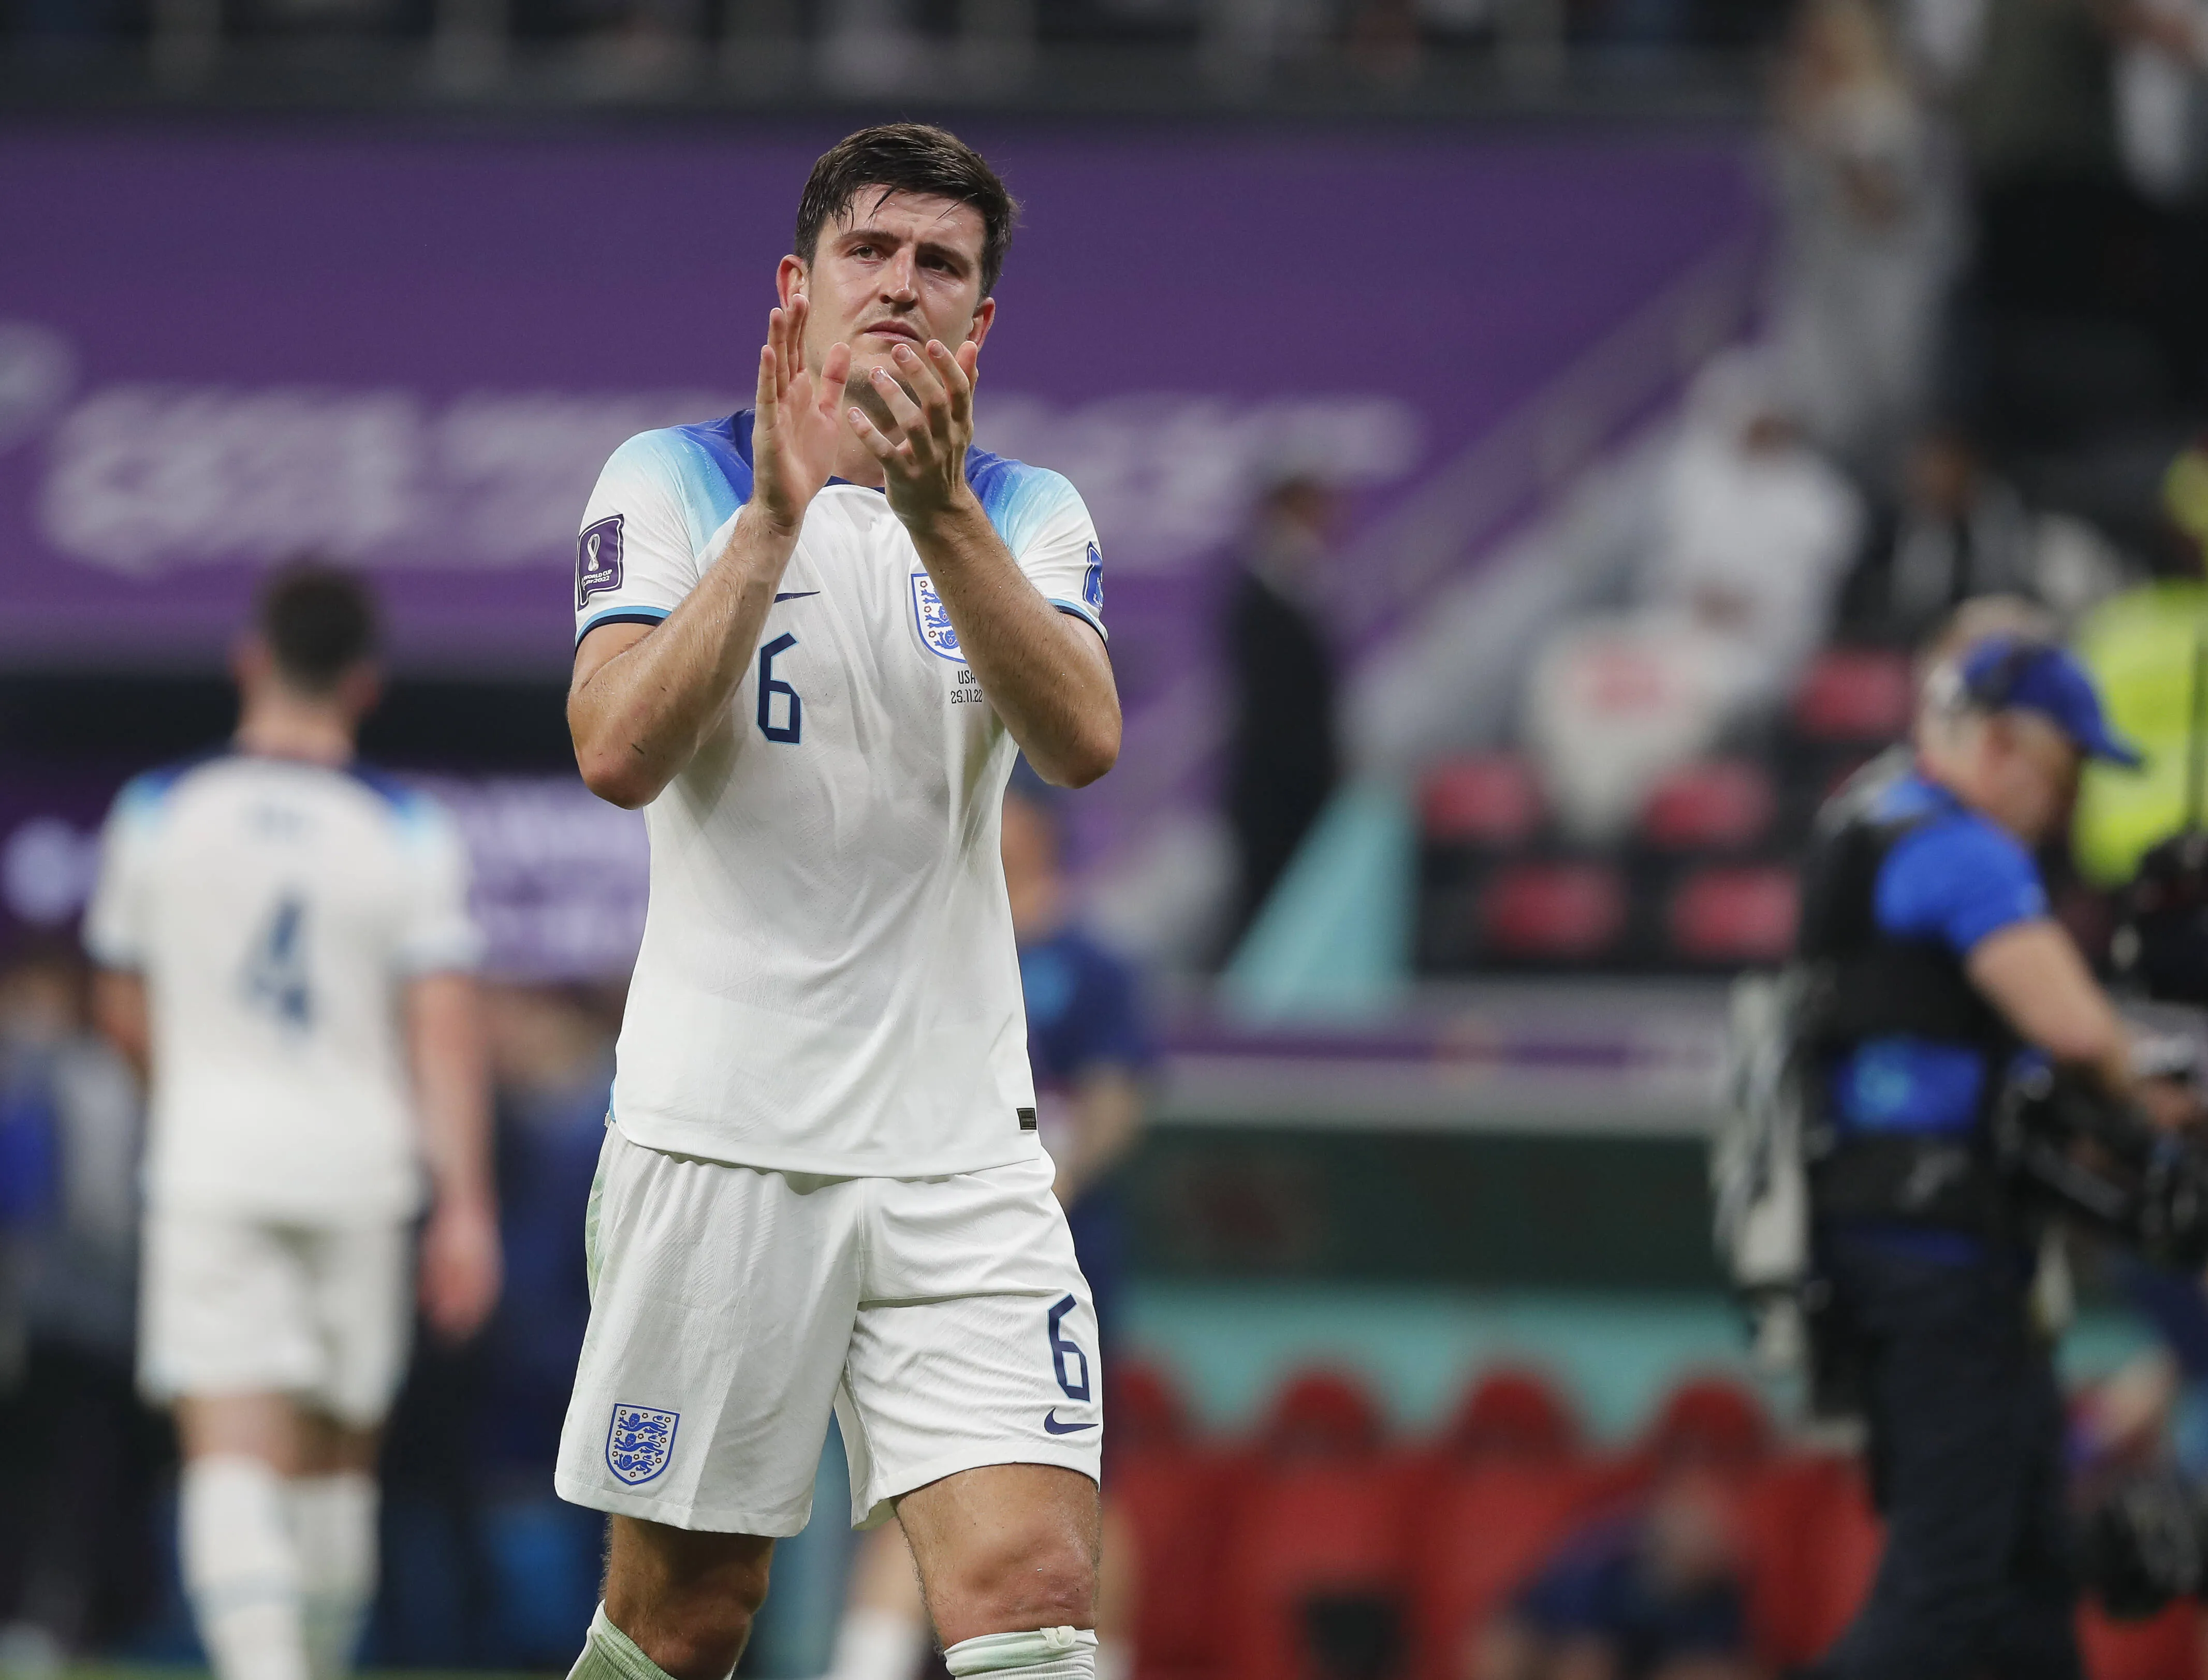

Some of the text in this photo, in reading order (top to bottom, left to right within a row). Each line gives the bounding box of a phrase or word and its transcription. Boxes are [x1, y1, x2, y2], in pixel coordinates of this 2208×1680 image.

[583, 572, 603, 580] WORLD
[756, 631, 801, 746] 6
[951, 689, 983, 704] 25.11.22
[958, 670, 976, 684] USA
[237, 883, 313, 1035] 4
[1047, 1292, 1091, 1404] 6
